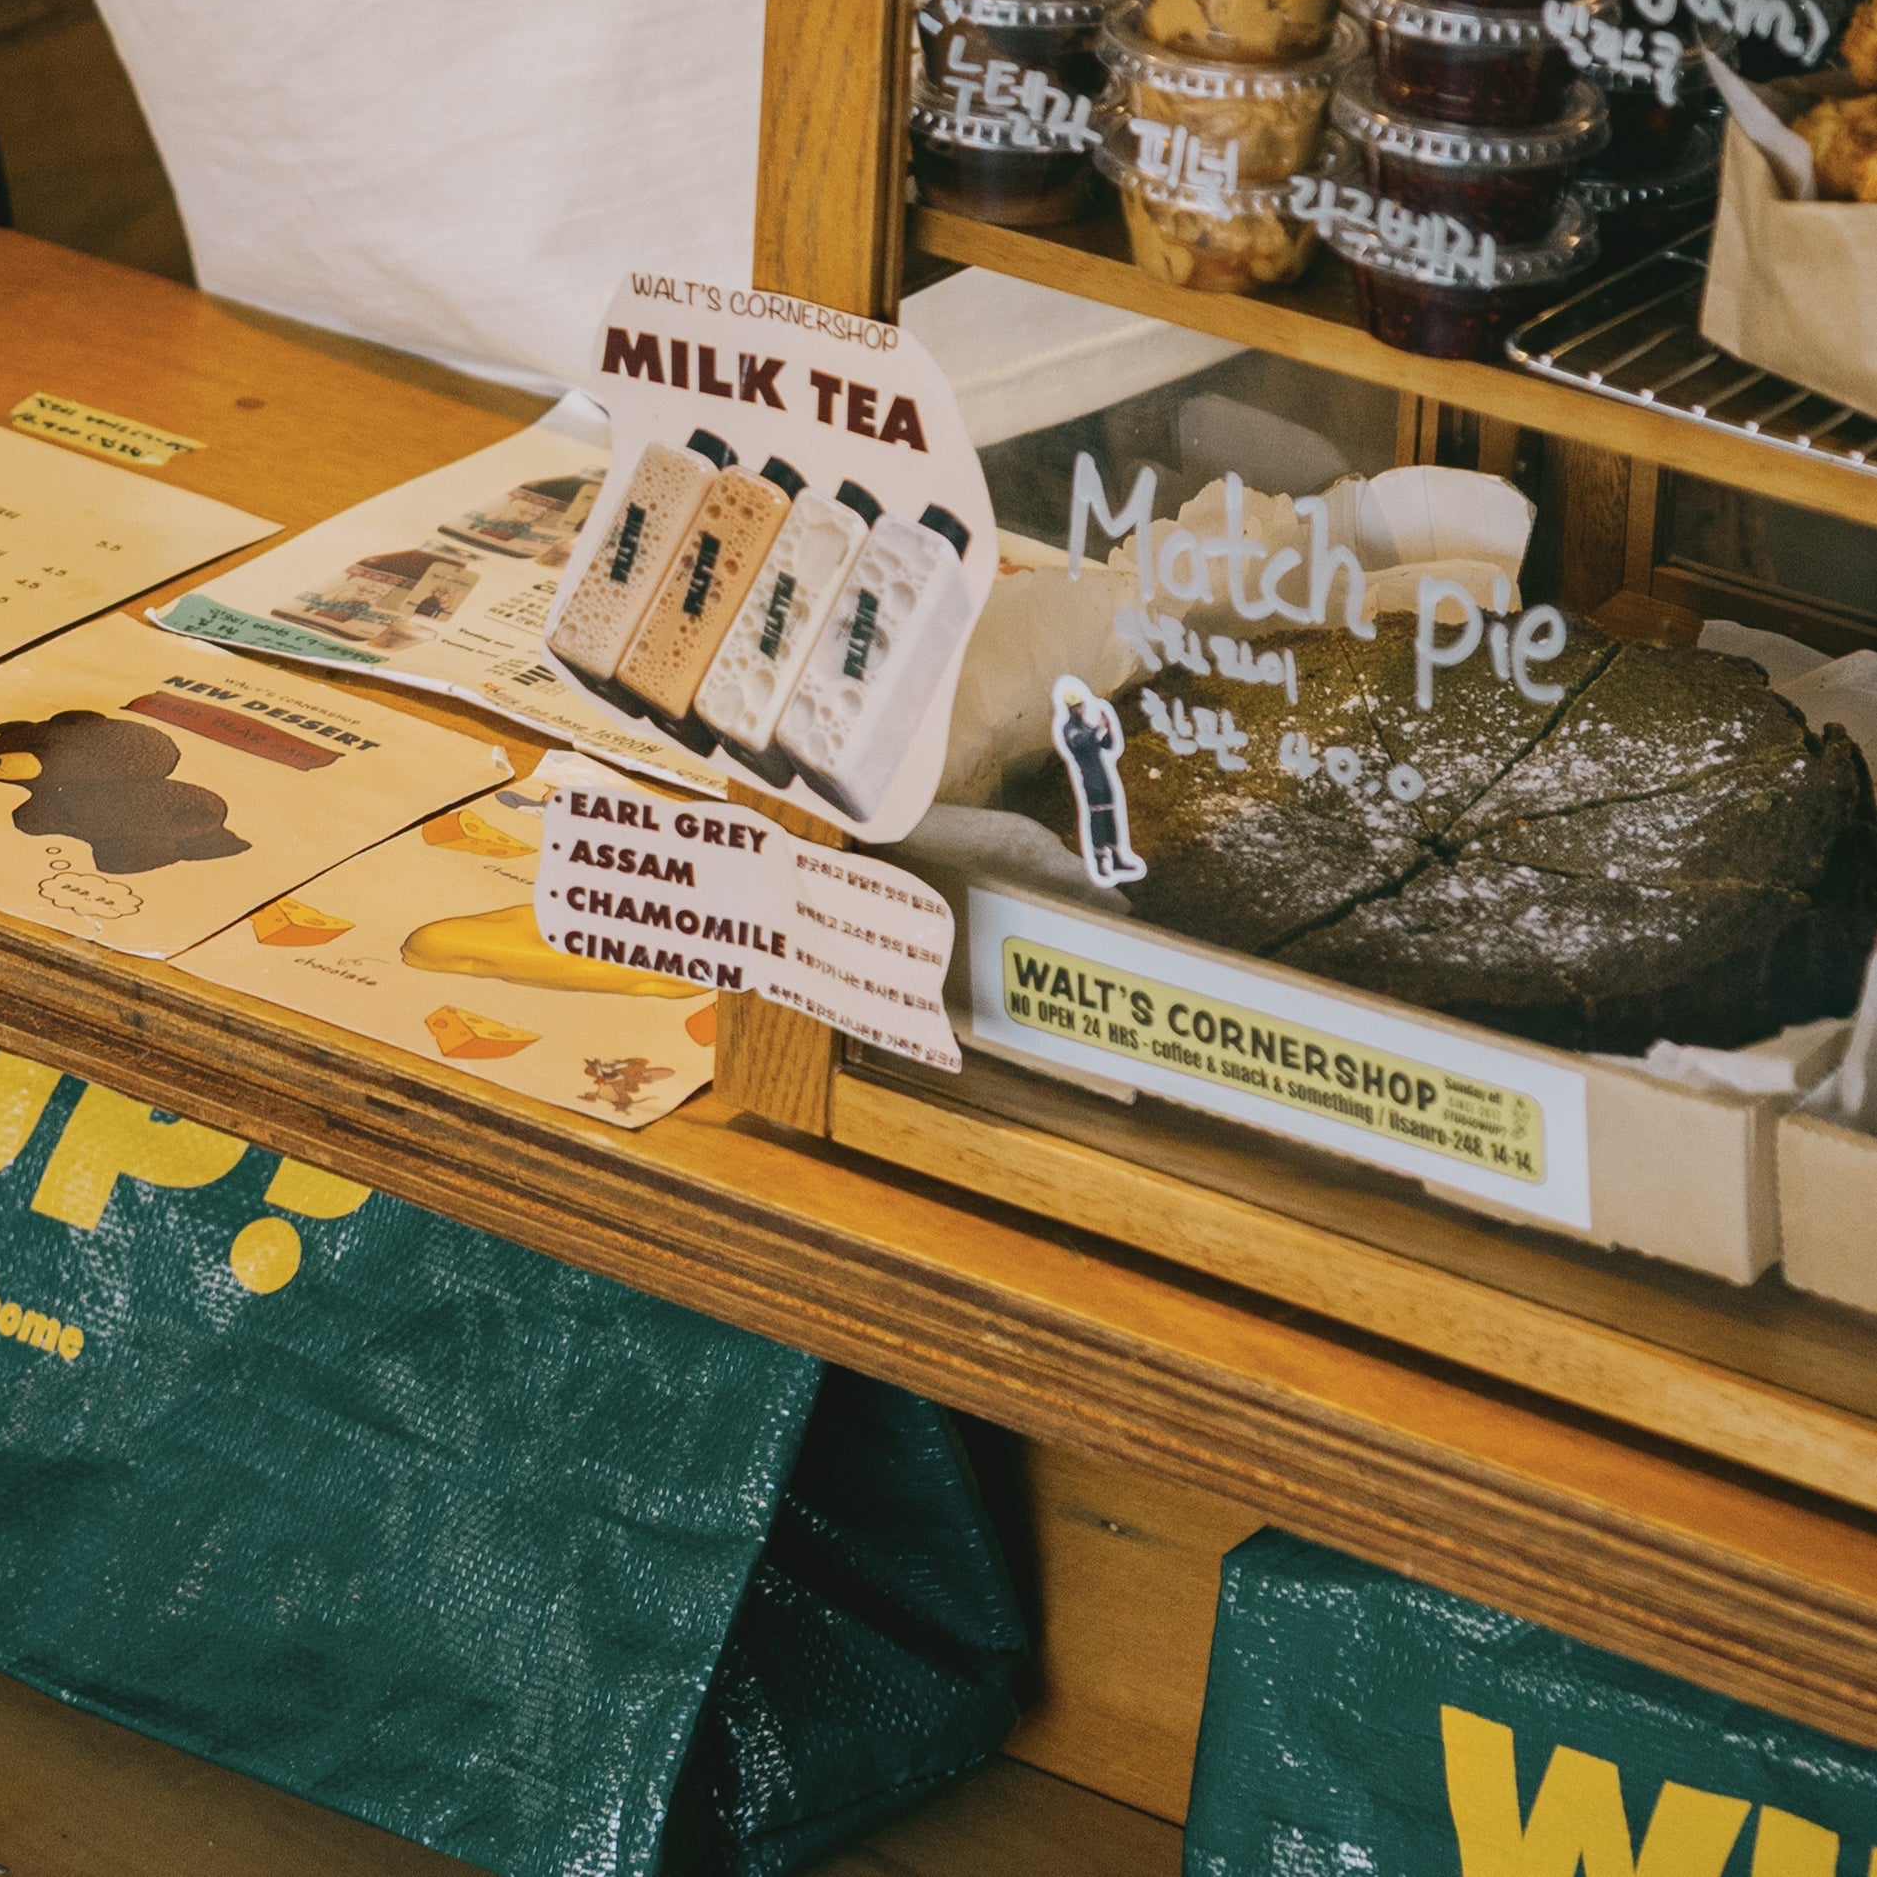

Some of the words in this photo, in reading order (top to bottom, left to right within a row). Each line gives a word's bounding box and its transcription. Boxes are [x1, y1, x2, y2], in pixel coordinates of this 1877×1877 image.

[631, 271, 724, 314] WALT'S
[728, 290, 900, 354] CORNERSHOP
[600, 325, 788, 414] MILK
[808, 367, 930, 454] TEA
[1068, 451, 1380, 639] Match
[1414, 572, 1571, 713] pie
[162, 674, 243, 702] NEW
[241, 698, 382, 752] DESSERT
[567, 790, 662, 834] EARL
[673, 810, 770, 855] GREY
[567, 837, 697, 889] ASSAM
[562, 929, 744, 991] CINAMON
[565, 884, 787, 959] CHAMOMILE
[291, 954, 380, 989] chocolate
[1010, 991, 1032, 1019] NO
[1037, 999, 1076, 1034] OPEN
[1081, 1012, 1103, 1041] 24
[1108, 1021, 1140, 1052] HRS
[1150, 1037, 1204, 1073] coffee
[1219, 1058, 1270, 1093] snack
[1286, 1079, 1375, 1127] something
[1012, 950, 1156, 1029] WALT'S
[1167, 1003, 1438, 1112] CORNERSHOP
